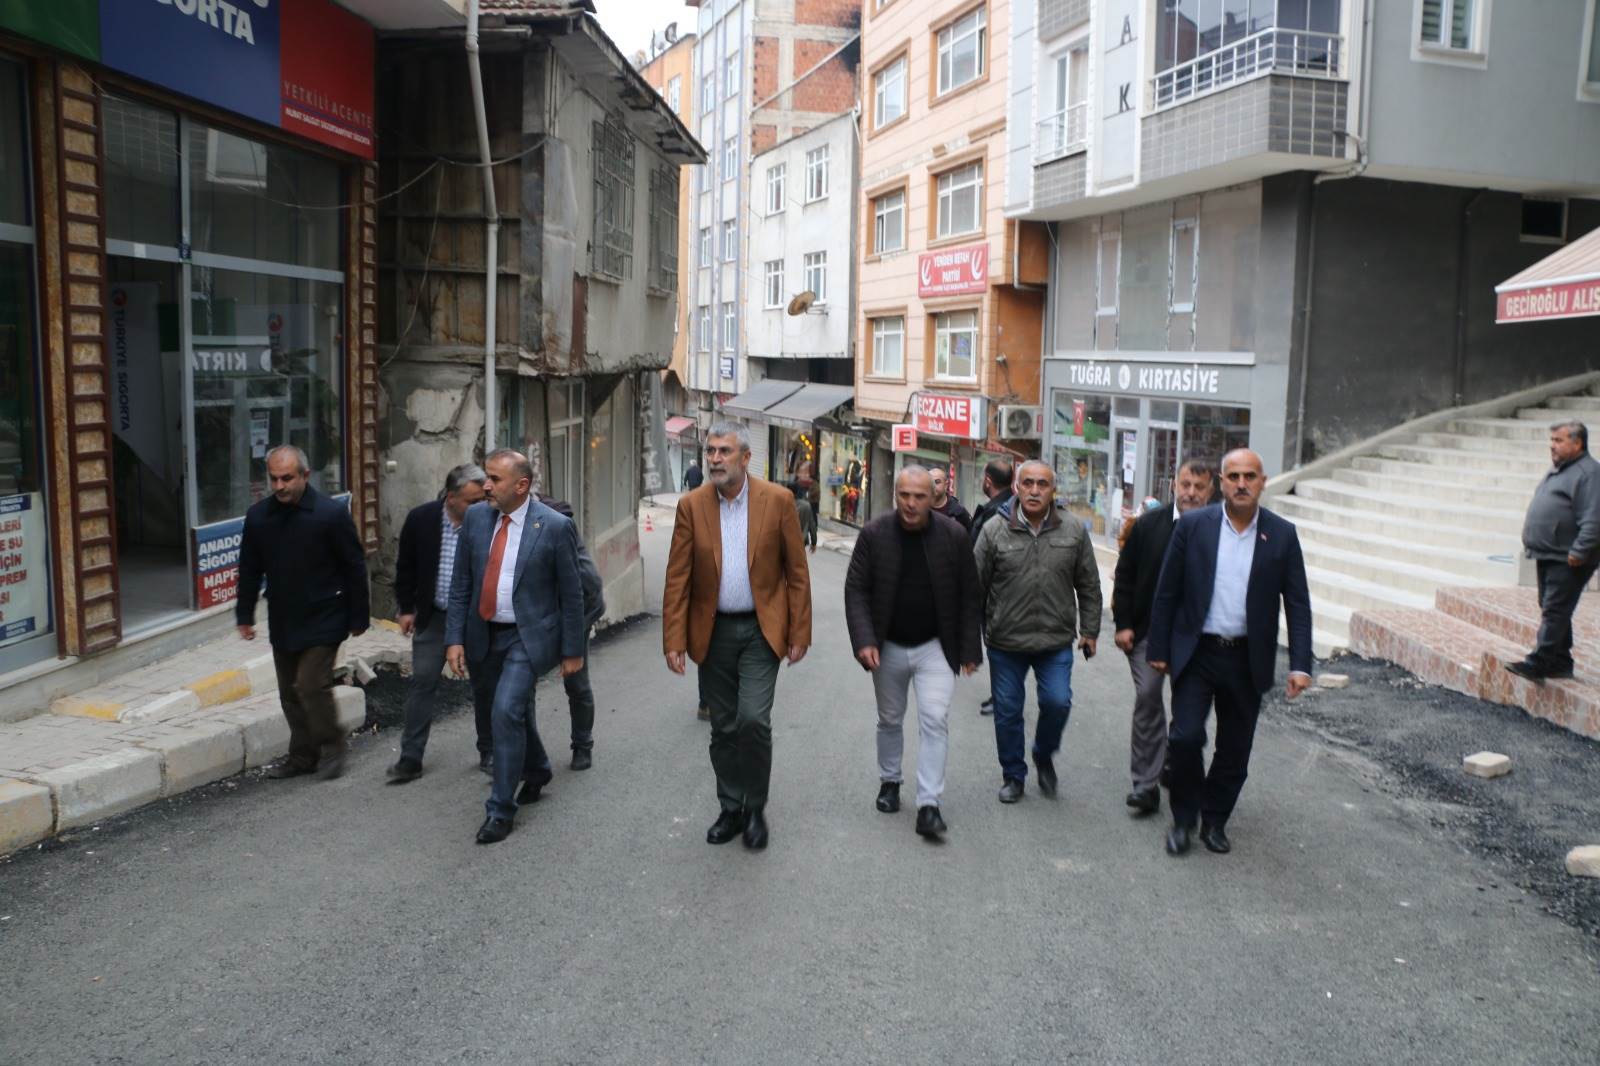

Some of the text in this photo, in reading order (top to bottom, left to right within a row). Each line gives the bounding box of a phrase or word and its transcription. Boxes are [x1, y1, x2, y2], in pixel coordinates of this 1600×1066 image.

[332, 101, 373, 129] ACENTE
[1070, 361, 1219, 393] TUĞRA KIRTASİYE
[918, 397, 968, 421] ECZANE
[899, 431, 911, 447] E
[8, 536, 23, 550] SU
[199, 534, 243, 556] ANADO
[204, 568, 239, 589] MAPF
[211, 585, 238, 602] Sigor
